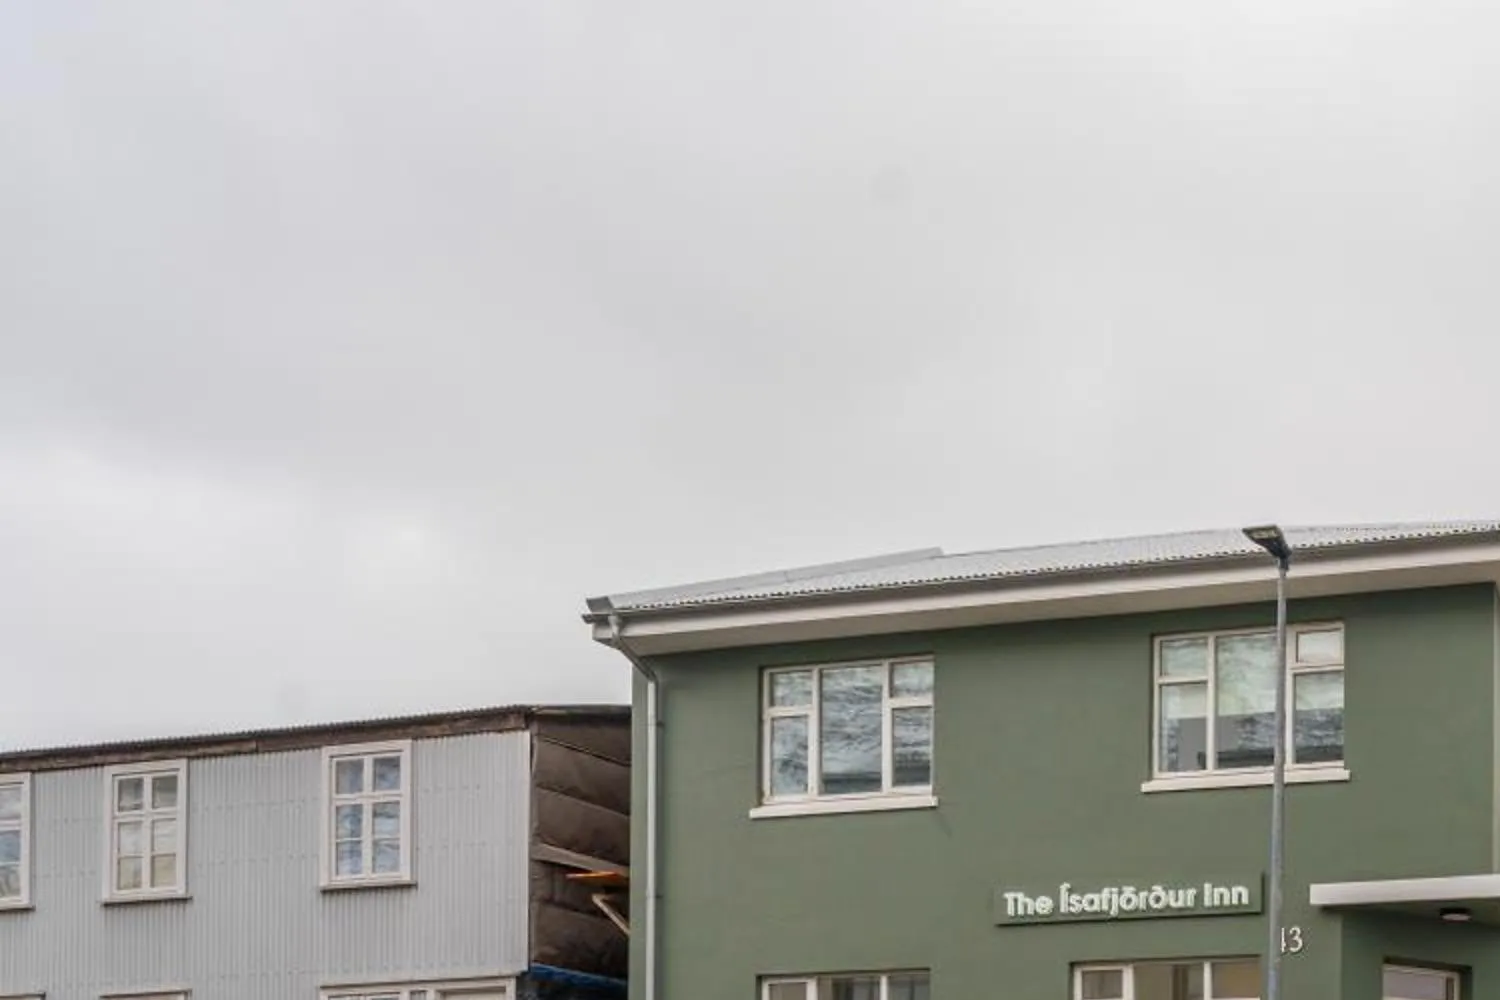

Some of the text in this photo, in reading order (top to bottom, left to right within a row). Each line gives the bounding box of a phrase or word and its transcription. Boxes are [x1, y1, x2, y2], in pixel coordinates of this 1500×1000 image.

[1004, 882, 1248, 917] The Ísafjörður Inn
